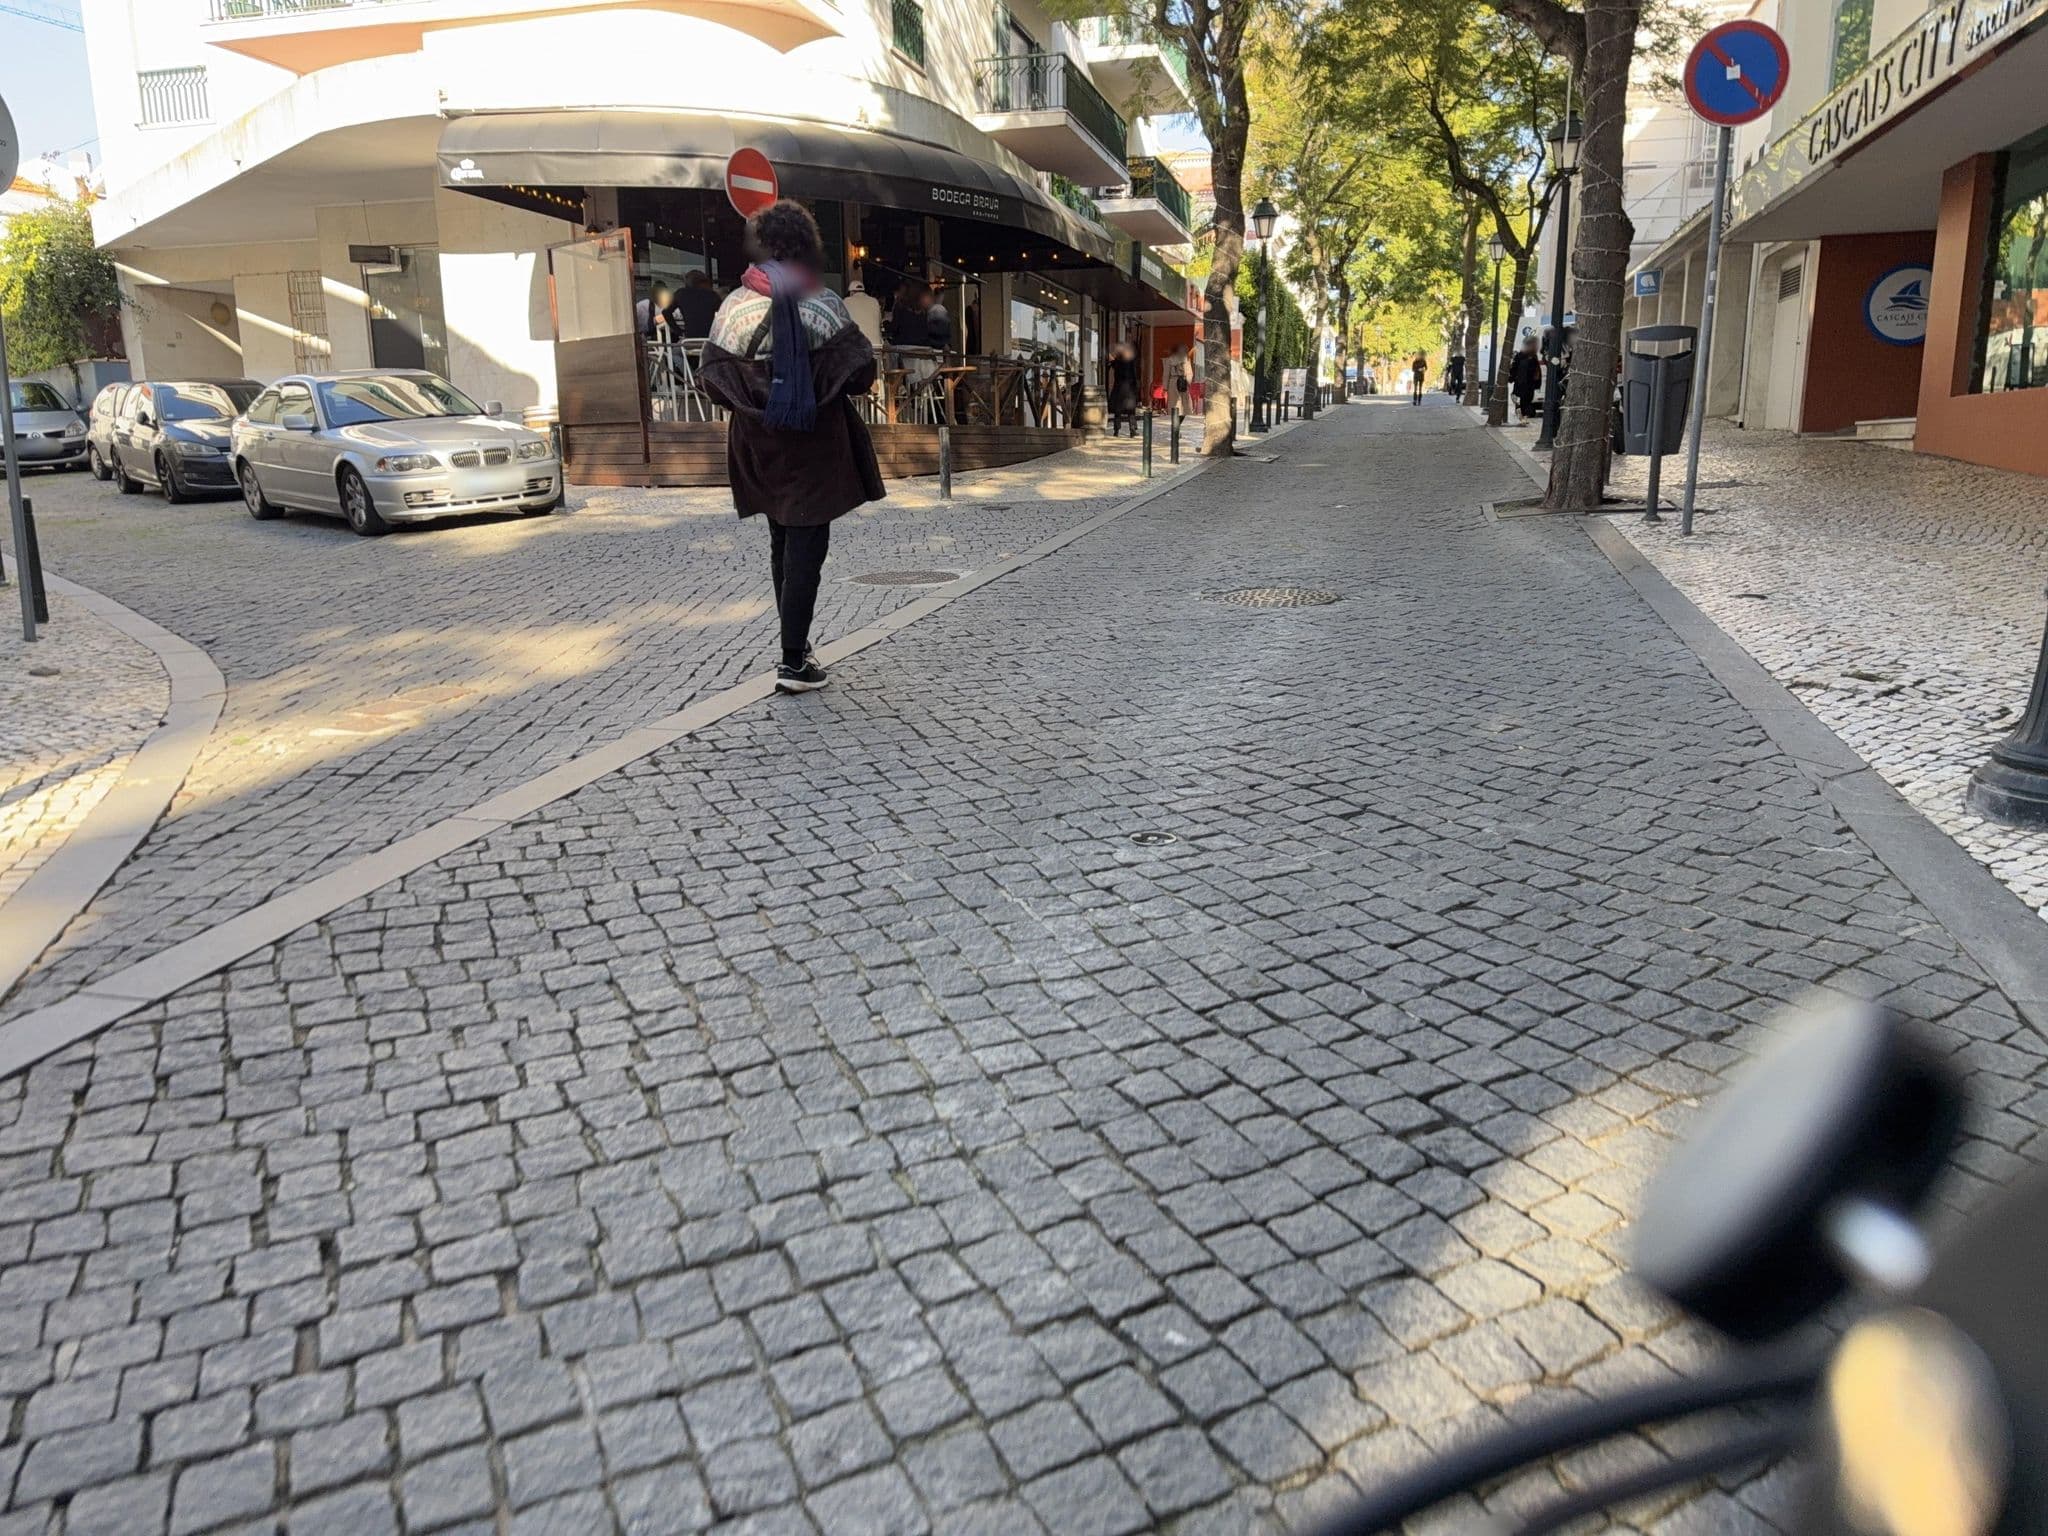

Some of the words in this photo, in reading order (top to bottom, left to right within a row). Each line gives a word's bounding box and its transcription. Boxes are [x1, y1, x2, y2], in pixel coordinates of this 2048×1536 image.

[1808, 57, 1895, 165] CASCAIS
[1900, 0, 1966, 97] CITY
[932, 188, 971, 205] BODEGA
[973, 195, 999, 210] BRAVA
